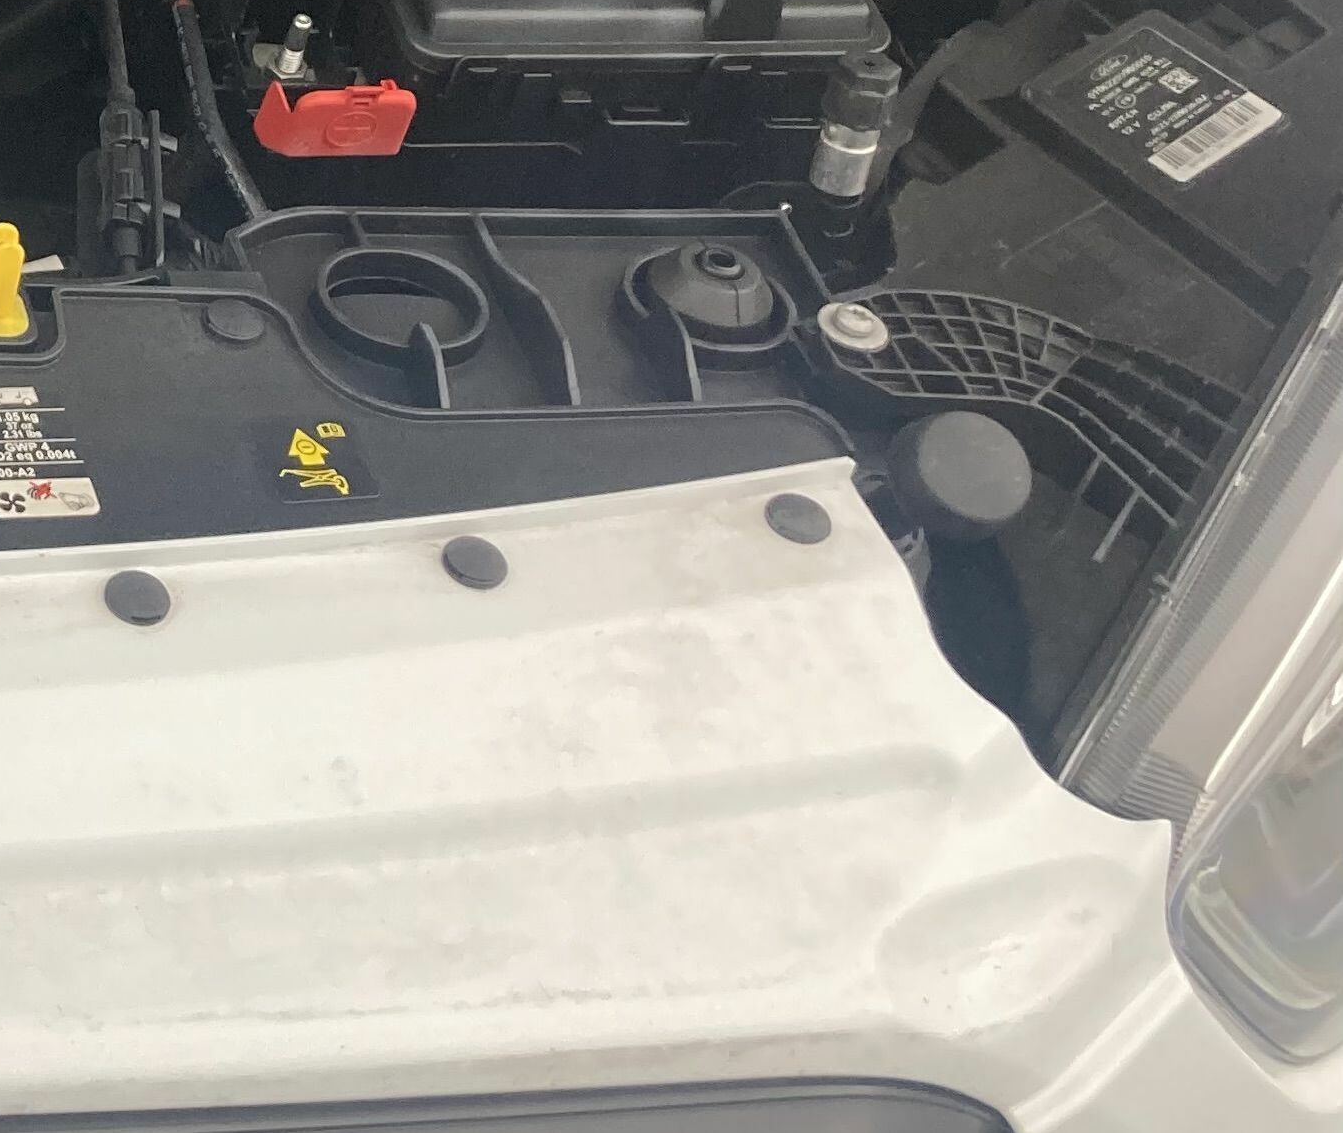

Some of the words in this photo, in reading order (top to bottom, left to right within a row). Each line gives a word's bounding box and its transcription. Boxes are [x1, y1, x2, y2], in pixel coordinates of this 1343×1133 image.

[22, 412, 40, 424] kg
[4, 442, 38, 452] GWP
[41, 441, 50, 451] 4
